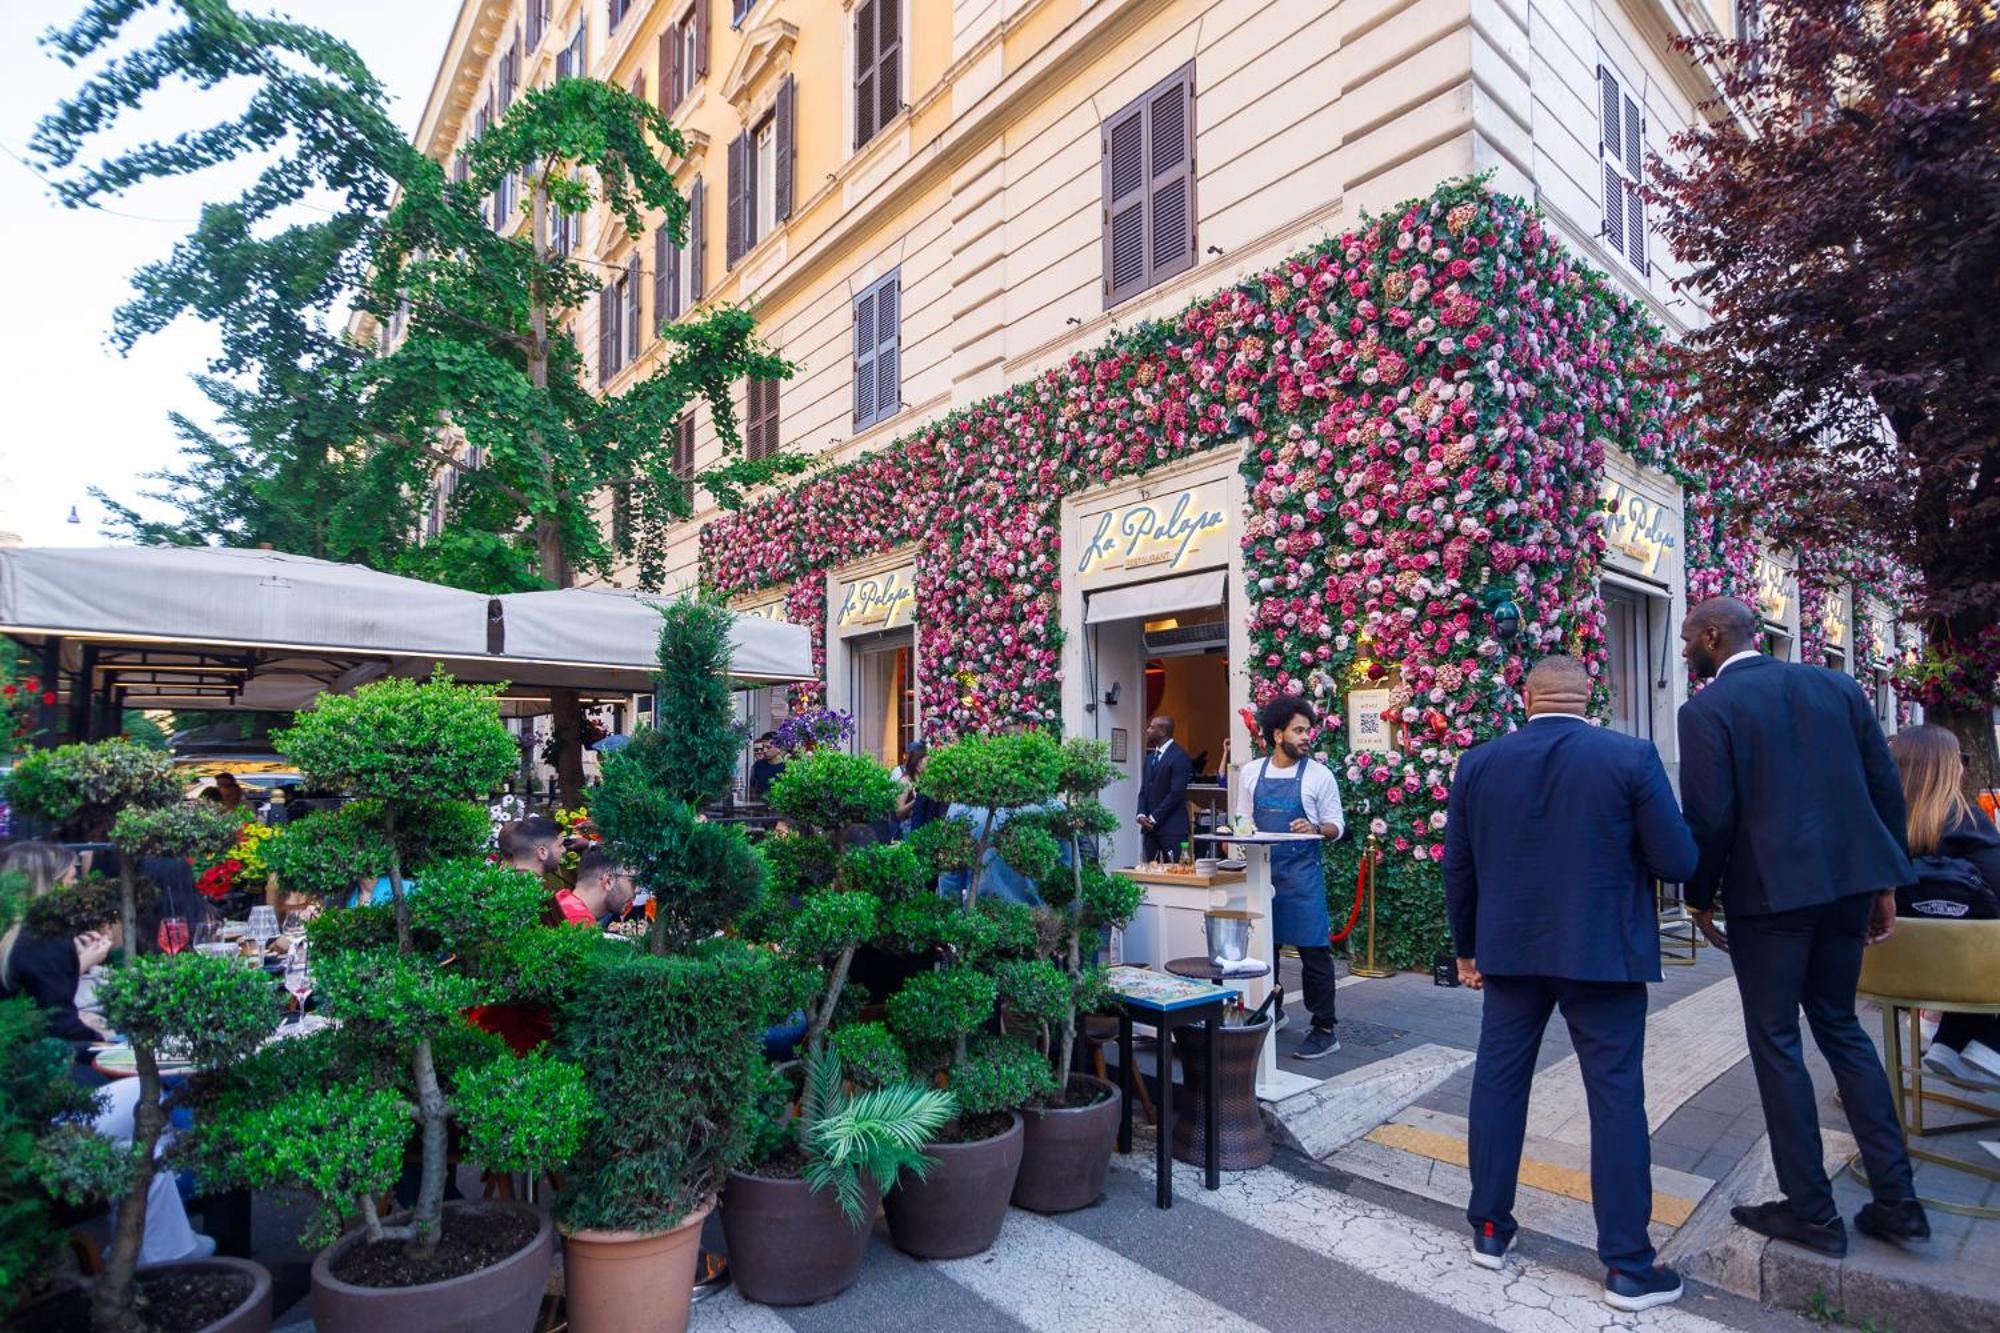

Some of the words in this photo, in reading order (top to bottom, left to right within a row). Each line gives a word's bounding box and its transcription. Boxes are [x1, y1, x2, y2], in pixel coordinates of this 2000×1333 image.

[1078, 511, 1117, 573] La
[1122, 492, 1224, 569] Palapa
[837, 583, 857, 625] La
[860, 574, 910, 627] Palapa
